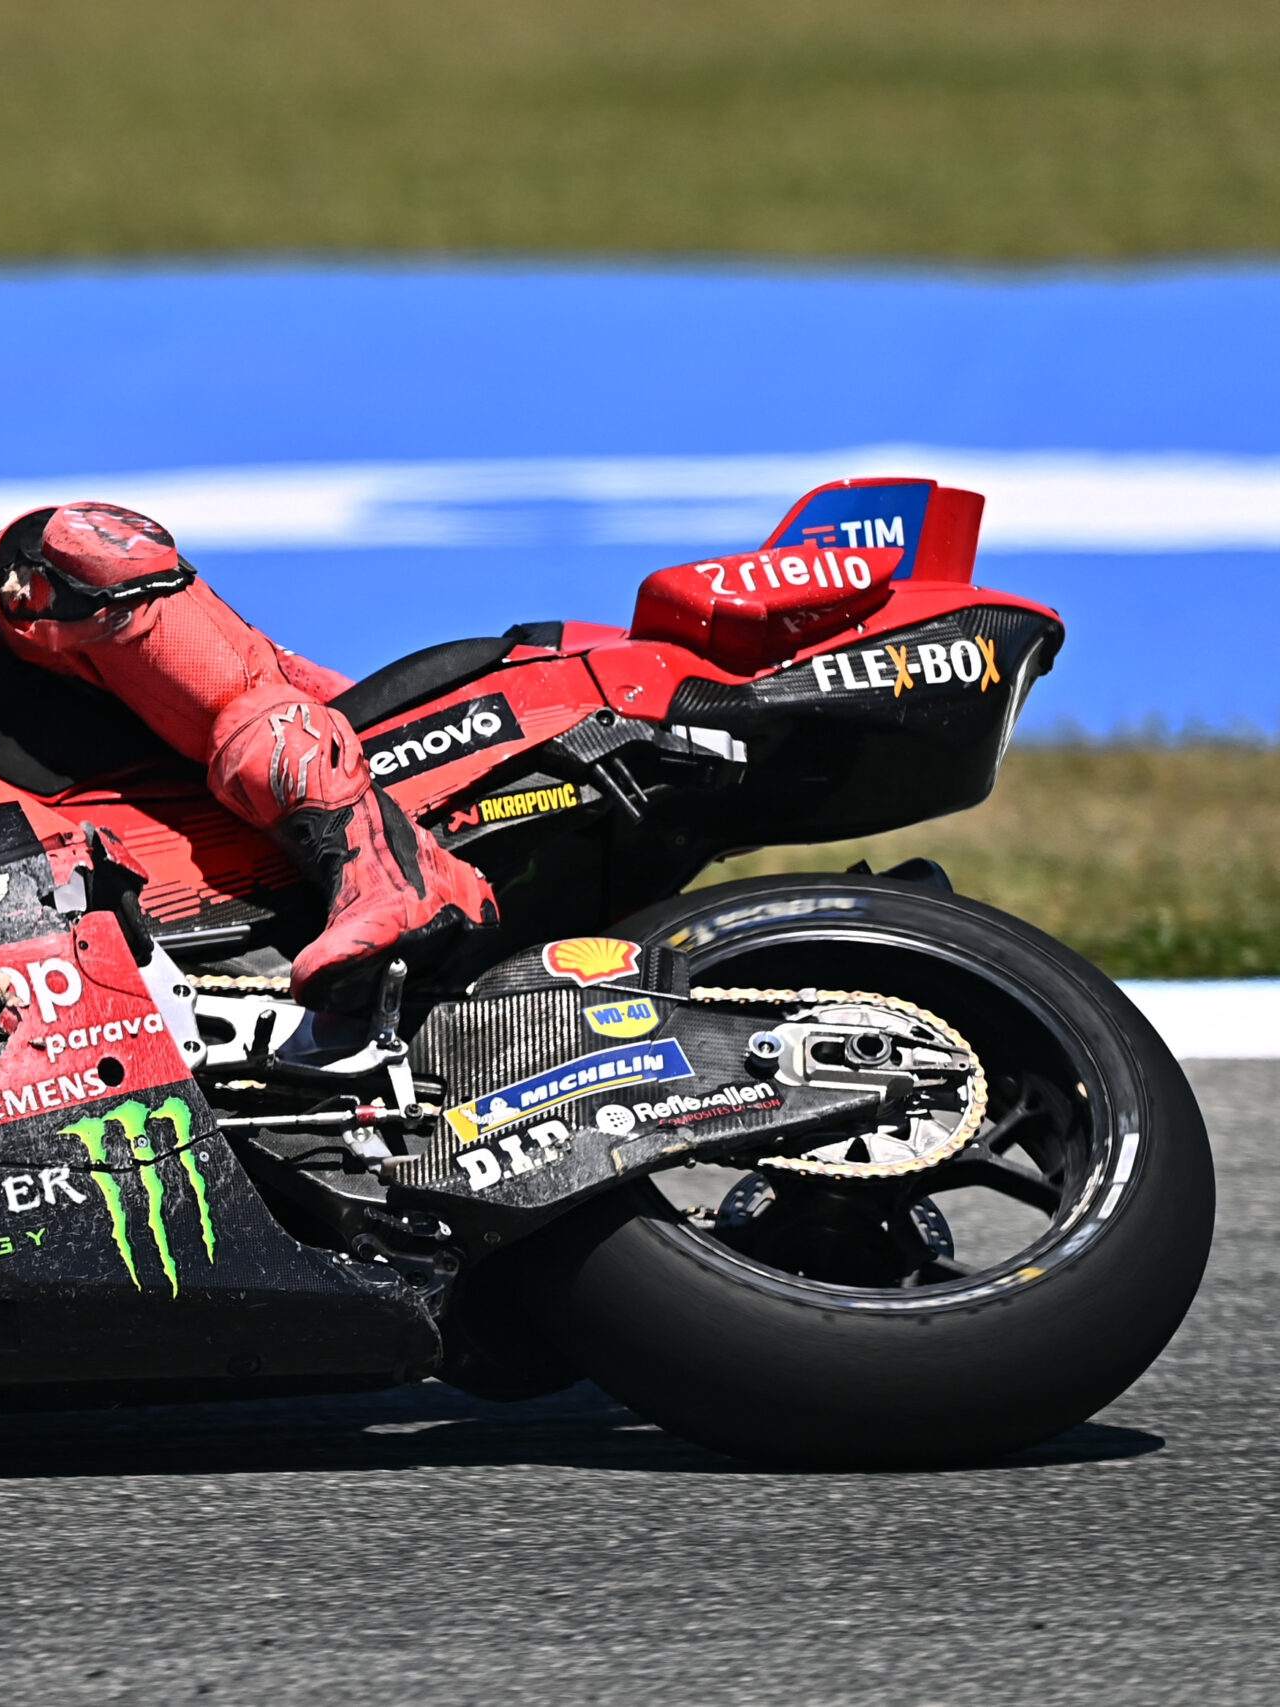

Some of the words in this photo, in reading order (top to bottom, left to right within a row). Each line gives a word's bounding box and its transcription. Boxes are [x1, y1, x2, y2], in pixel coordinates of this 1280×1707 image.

[840, 516, 905, 548] TIM
[811, 634, 1001, 698] FLEX-BOX
[369, 711, 502, 780] enovo
[591, 1002, 652, 1026] WD-40
[520, 1053, 664, 1108] MICHELIN
[632, 1081, 775, 1123] Reflexallen
